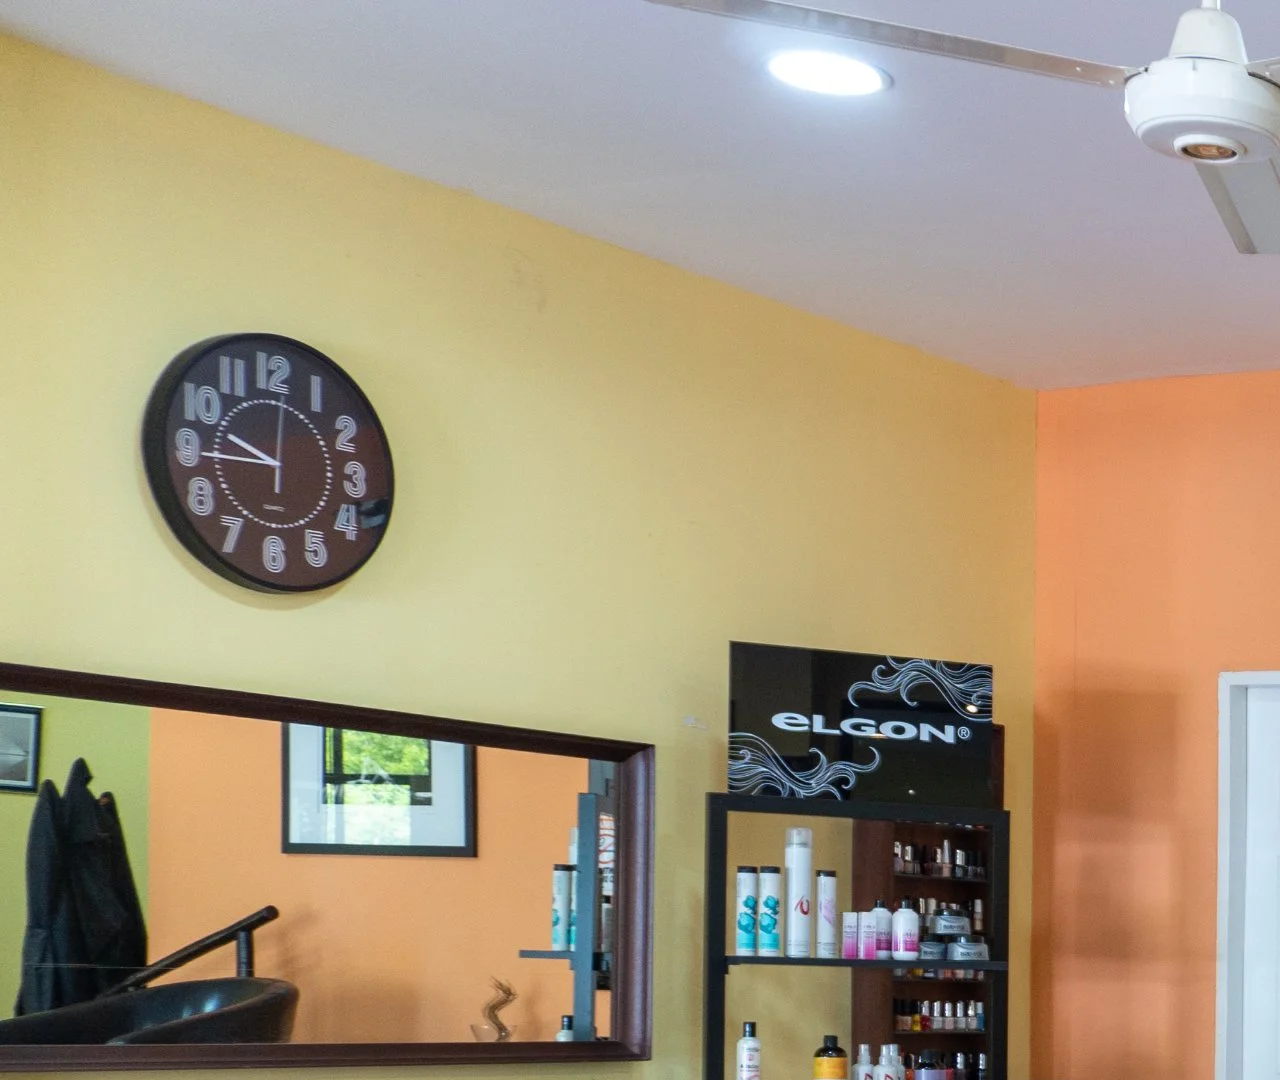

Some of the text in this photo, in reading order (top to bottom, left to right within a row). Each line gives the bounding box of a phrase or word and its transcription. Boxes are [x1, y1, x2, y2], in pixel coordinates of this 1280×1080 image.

[219, 356, 246, 397] 11
[256, 351, 291, 394] 12
[183, 382, 221, 424] 10
[310, 375, 321, 412] 1
[175, 428, 200, 467] 9
[335, 416, 358, 452] 2
[188, 477, 215, 515] 8
[343, 462, 366, 497] 3
[220, 516, 244, 552] 7
[334, 504, 358, 540] 4
[263, 536, 286, 572] 6
[305, 530, 328, 567] 5
